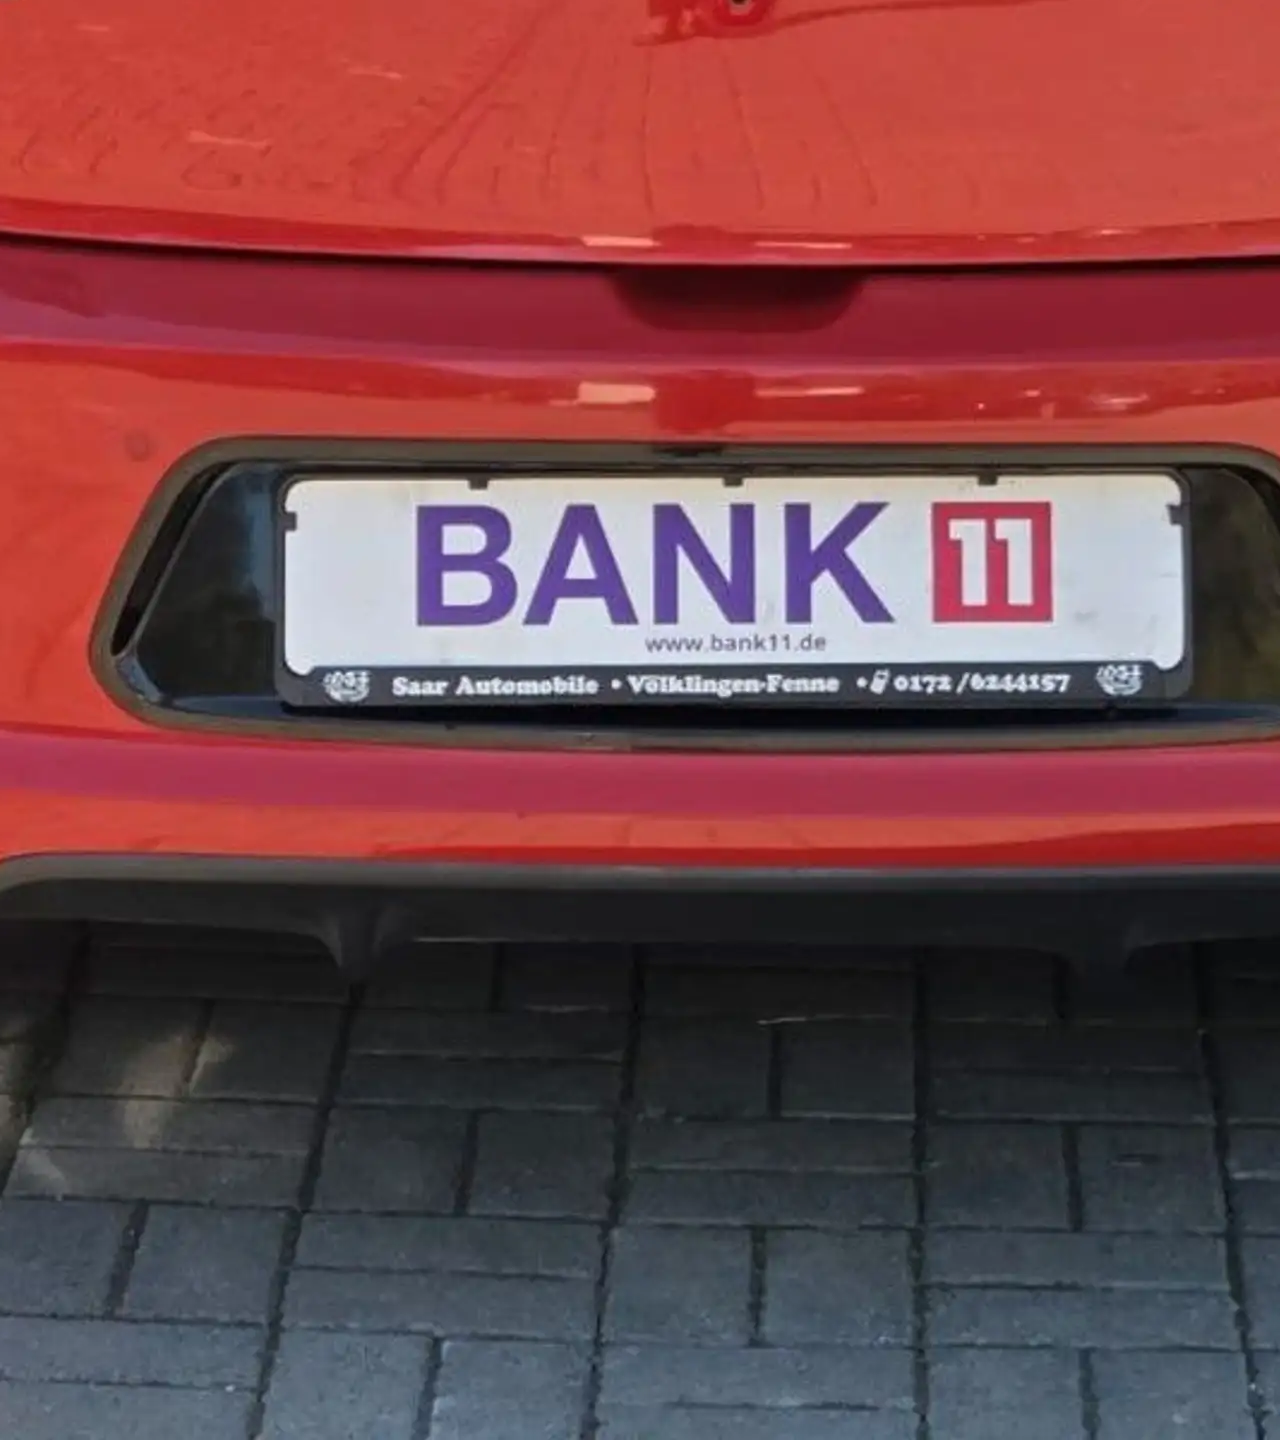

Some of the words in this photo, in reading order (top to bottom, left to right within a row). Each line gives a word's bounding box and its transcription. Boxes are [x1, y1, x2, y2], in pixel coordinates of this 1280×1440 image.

[416, 502, 896, 627] BANK
[948, 517, 1034, 607] 11
[644, 634, 827, 653] www.bank11.de
[392, 676, 448, 696] Saar
[455, 676, 599, 696] Automobile
